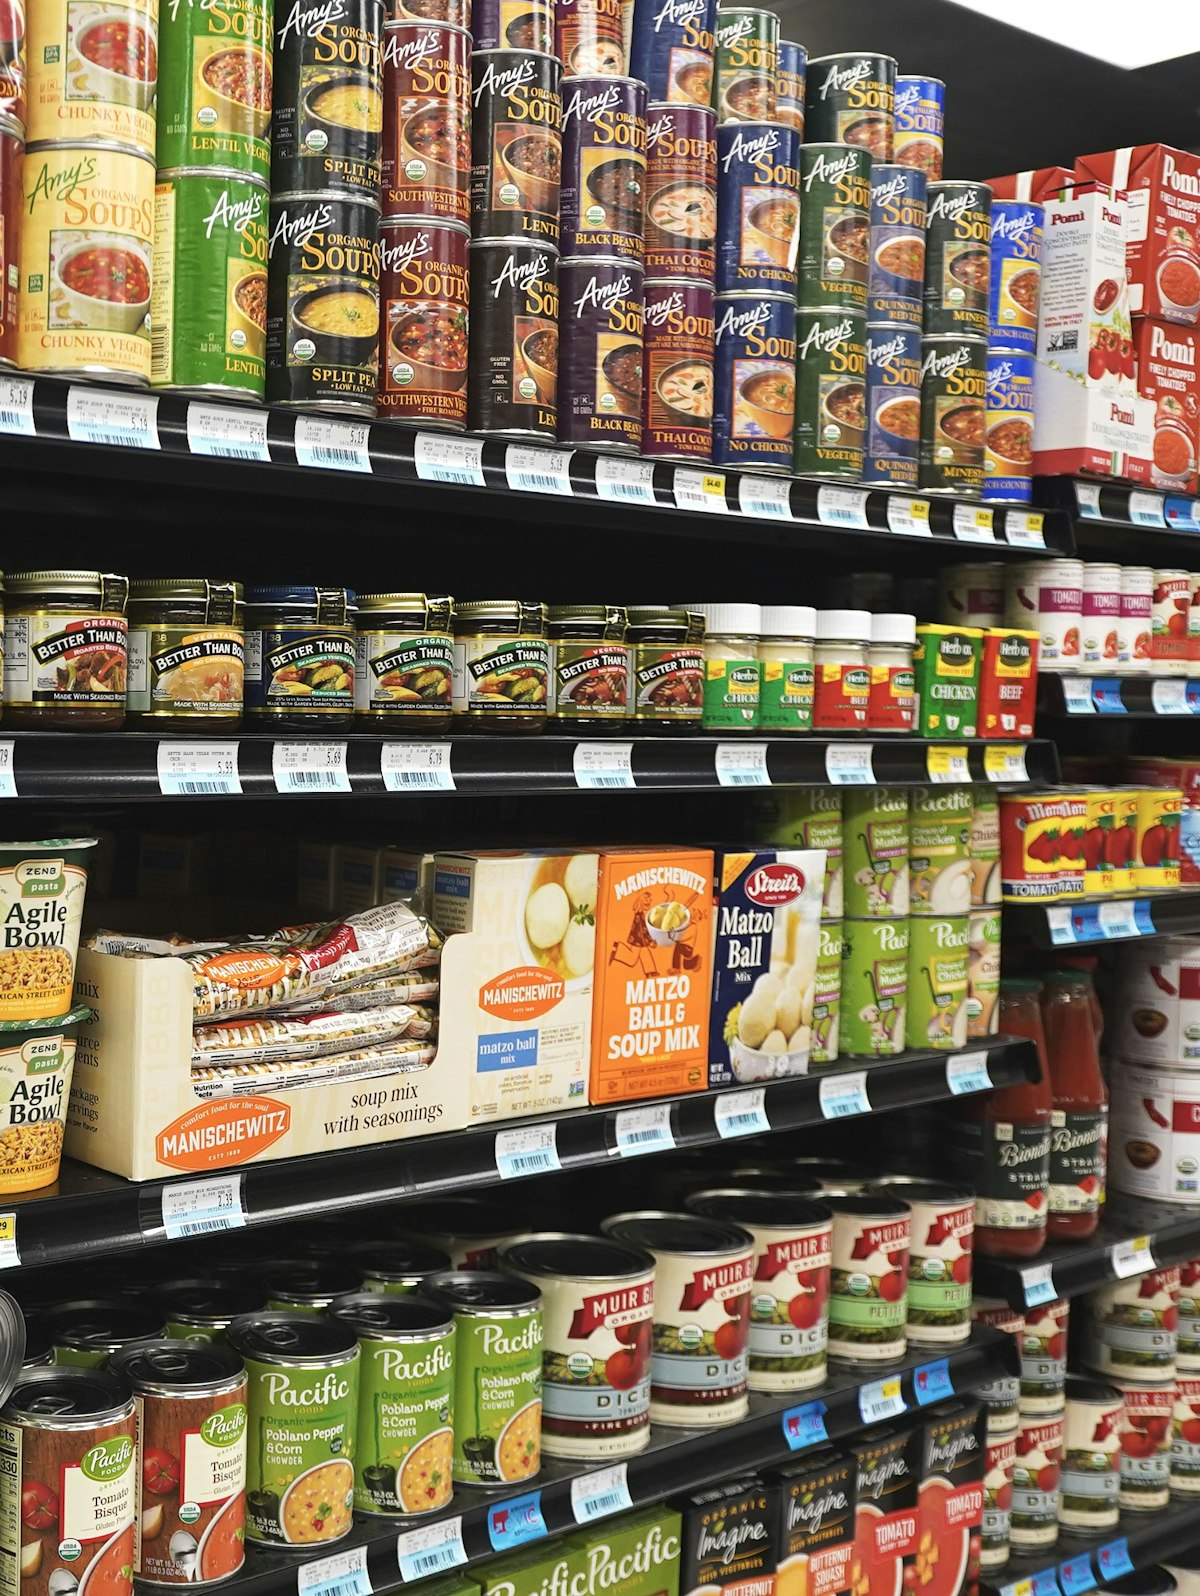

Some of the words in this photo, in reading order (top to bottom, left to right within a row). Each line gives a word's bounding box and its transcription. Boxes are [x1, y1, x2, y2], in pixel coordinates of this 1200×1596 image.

[473, 60, 539, 113] Amy's
[819, 60, 874, 101] Amy's
[560, 86, 624, 132] Amy's
[28, 156, 98, 215] Amy's
[203, 190, 265, 239] Amy's
[927, 189, 979, 229] Amy's
[270, 204, 336, 258] Amy's
[575, 233, 611, 247] BLACK
[612, 236, 635, 251] BEAN
[646, 254, 678, 266] THAI
[40, 334, 108, 351] CHUNKY
[312, 368, 354, 385] SPLIT
[358, 370, 376, 389] PEA
[9, 388, 28, 404] 5.19
[377, 394, 455, 413] SOUTHWESTERN
[349, 430, 365, 445] 5.19
[729, 439, 749, 452] NO
[751, 441, 788, 454] CHICKEN
[155, 649, 201, 673] BETTER
[205, 642, 231, 656] THAN
[270, 645, 314, 669] BETTER
[316, 640, 342, 654] THAN
[931, 684, 977, 700] CHICKEN
[999, 684, 1024, 700] BEEF
[327, 751, 342, 765] 5.69
[429, 753, 442, 765] 6.79
[25, 866, 57, 876] ZENB
[614, 867, 707, 901] MANISCHEWITZ
[748, 867, 801, 895] Streit's
[31, 881, 59, 894] pasta
[4, 899, 68, 929] Agile
[719, 906, 774, 937] Matzo
[3, 922, 65, 951] Bowl
[727, 936, 763, 969] Ball
[625, 975, 691, 1005] MATZO
[735, 972, 752, 983] Mix
[25, 991, 51, 999] STREET
[51, 990, 66, 998] CORN
[483, 981, 563, 1006] MANISCHEWITZ
[629, 1006, 673, 1032] BALL
[675, 1002, 685, 1024] &
[479, 1042, 514, 1056] matzo
[515, 1037, 536, 1052] ball
[608, 1034, 661, 1060] SOUP
[665, 1024, 701, 1051] MIX
[500, 1053, 516, 1065] mix
[193, 1082, 224, 1094] Nutrition
[351, 1092, 387, 1109] soup
[390, 1083, 419, 1102] mix
[180, 1108, 210, 1130] comfort
[211, 1104, 228, 1115] food
[229, 1102, 240, 1111] for
[254, 1102, 269, 1111] soul
[323, 1115, 360, 1136] with
[362, 1104, 443, 1130] seasonings
[162, 1109, 286, 1159] MANISCHEWITZ
[870, 1223, 904, 1245] MUIR
[593, 1289, 639, 1318] MUIR
[260, 1372, 350, 1407] Pacific
[266, 1428, 311, 1442] Poblano
[313, 1423, 345, 1441] Pepper
[593, 1420, 623, 1431] FIRE
[87, 1442, 133, 1471] Pacific
[266, 1443, 276, 1455] &
[276, 1443, 303, 1455] Corn
[266, 1455, 303, 1466] CHOWDER
[928, 1432, 979, 1474] Imagine
[0, 1461, 18, 1475] 330
[92, 1488, 129, 1508] Tomato
[94, 1500, 129, 1520] Bisque
[946, 1489, 982, 1518] TOMATO
[702, 1498, 767, 1526] ORGANIC
[697, 1518, 768, 1565] Imagine
[587, 1527, 681, 1590] Pacific
[810, 1546, 853, 1574] BUTTERNUT
[815, 1564, 846, 1587] SQUASH
